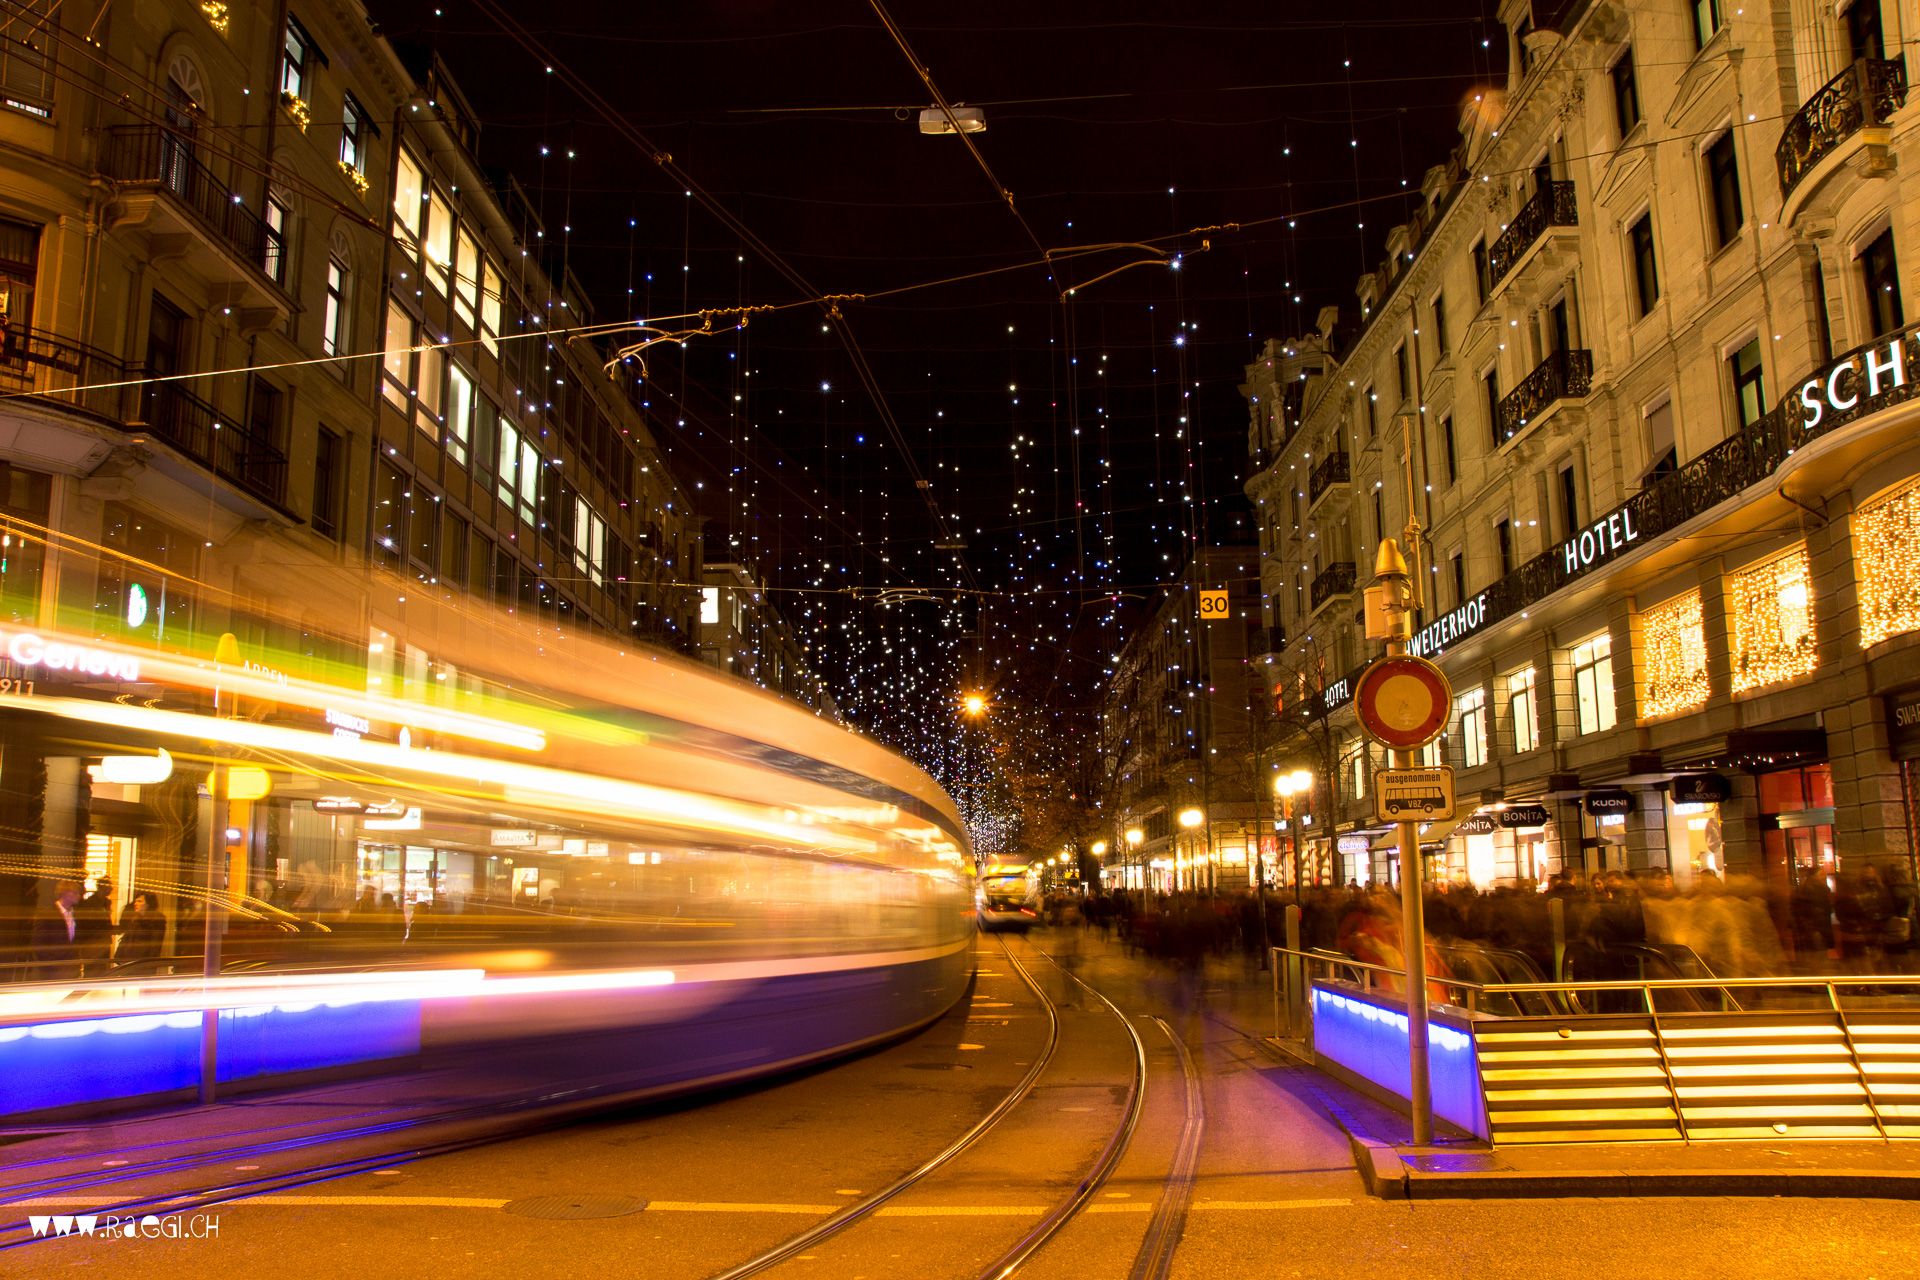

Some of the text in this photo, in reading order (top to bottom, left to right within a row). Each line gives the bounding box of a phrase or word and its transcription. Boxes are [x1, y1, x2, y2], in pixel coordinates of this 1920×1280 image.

[1565, 332, 1920, 574] HOTEL SCH
[1202, 597, 1228, 613] 30
[8, 632, 140, 682] Genova
[1385, 773, 1441, 785] ausgenommen
[1407, 799, 1422, 809] VBZ
[1592, 799, 1627, 807] KUONI
